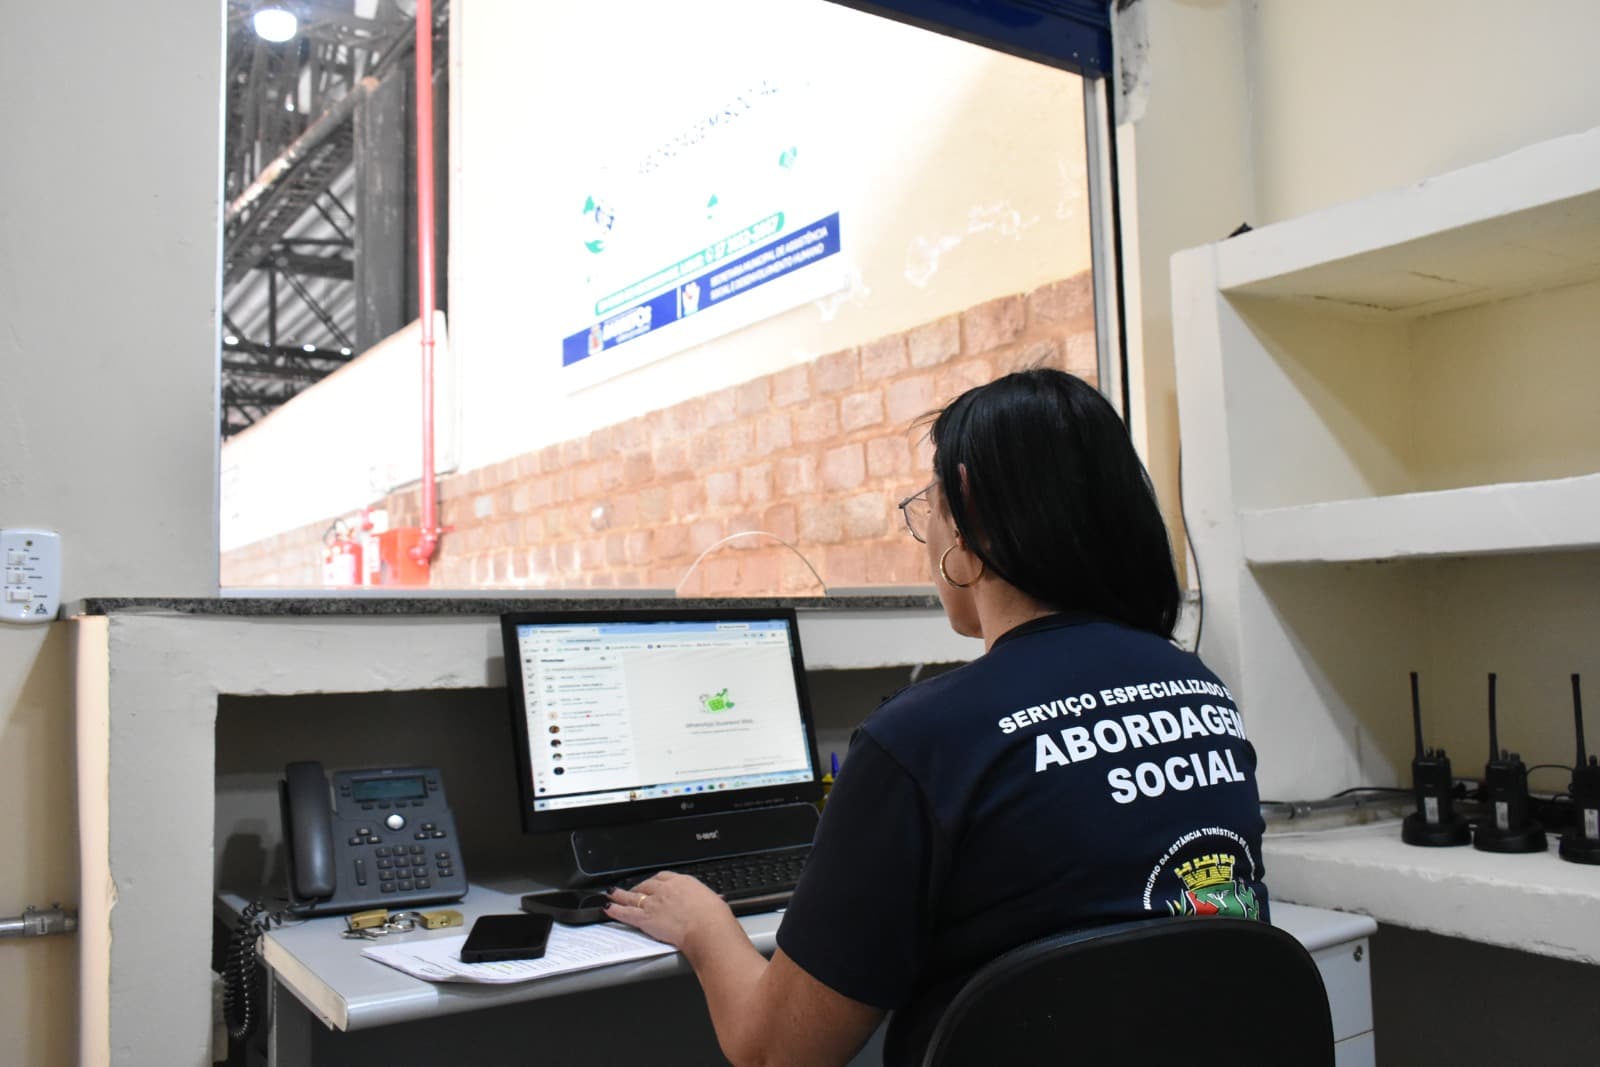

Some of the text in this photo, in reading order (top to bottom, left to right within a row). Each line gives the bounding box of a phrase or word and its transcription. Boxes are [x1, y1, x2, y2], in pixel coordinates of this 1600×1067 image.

[998, 693, 1098, 734] SERVIÇO
[1100, 679, 1225, 707] ESPECIALIZADO
[1035, 704, 1246, 773] ABORDAGEM
[1107, 748, 1246, 804] SOCIAL
[1159, 854, 1170, 865] DA
[1168, 830, 1202, 855] ESTÂNCIA
[1201, 826, 1239, 841] TURÍSTICA
